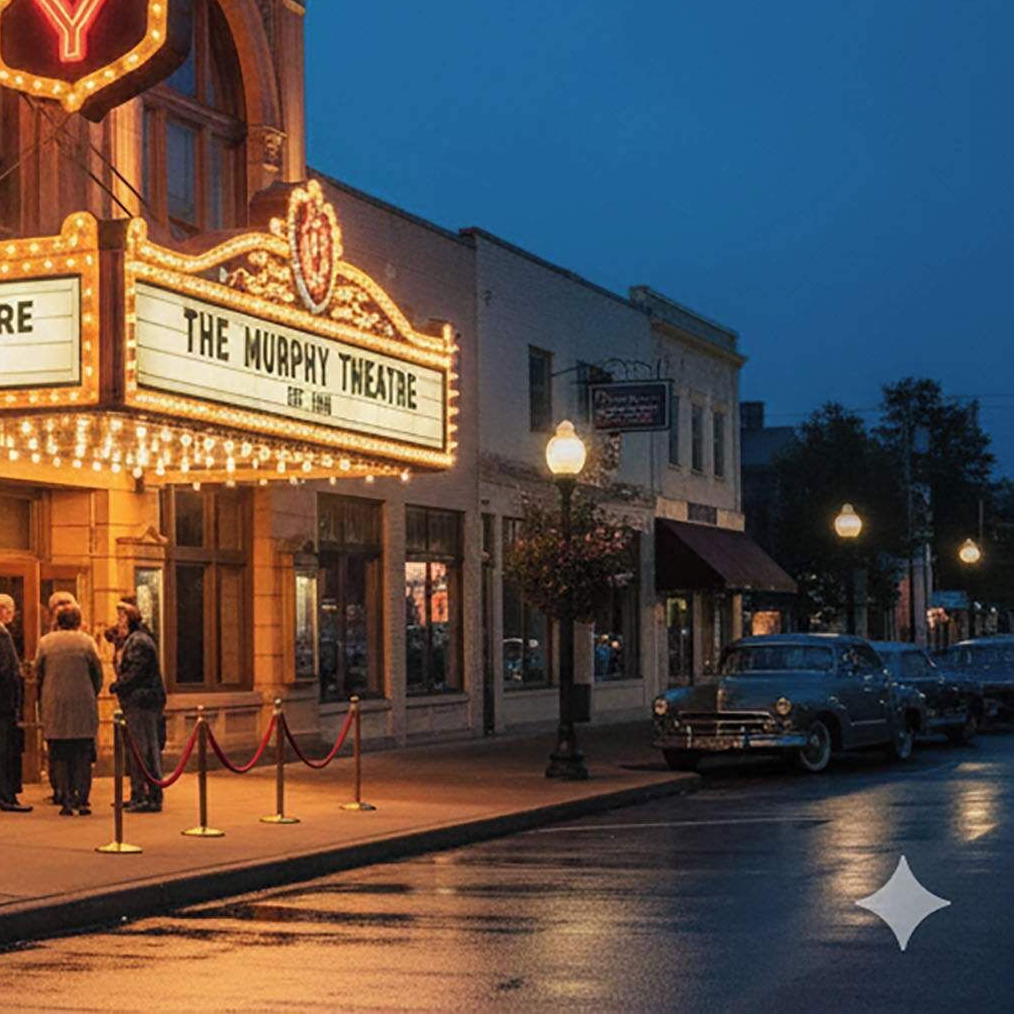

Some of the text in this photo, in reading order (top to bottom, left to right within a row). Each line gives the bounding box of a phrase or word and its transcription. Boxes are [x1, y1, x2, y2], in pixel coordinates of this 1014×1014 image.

[183, 307, 229, 361] THE
[244, 325, 329, 386] MURPHY
[338, 351, 417, 410] THEATRE
